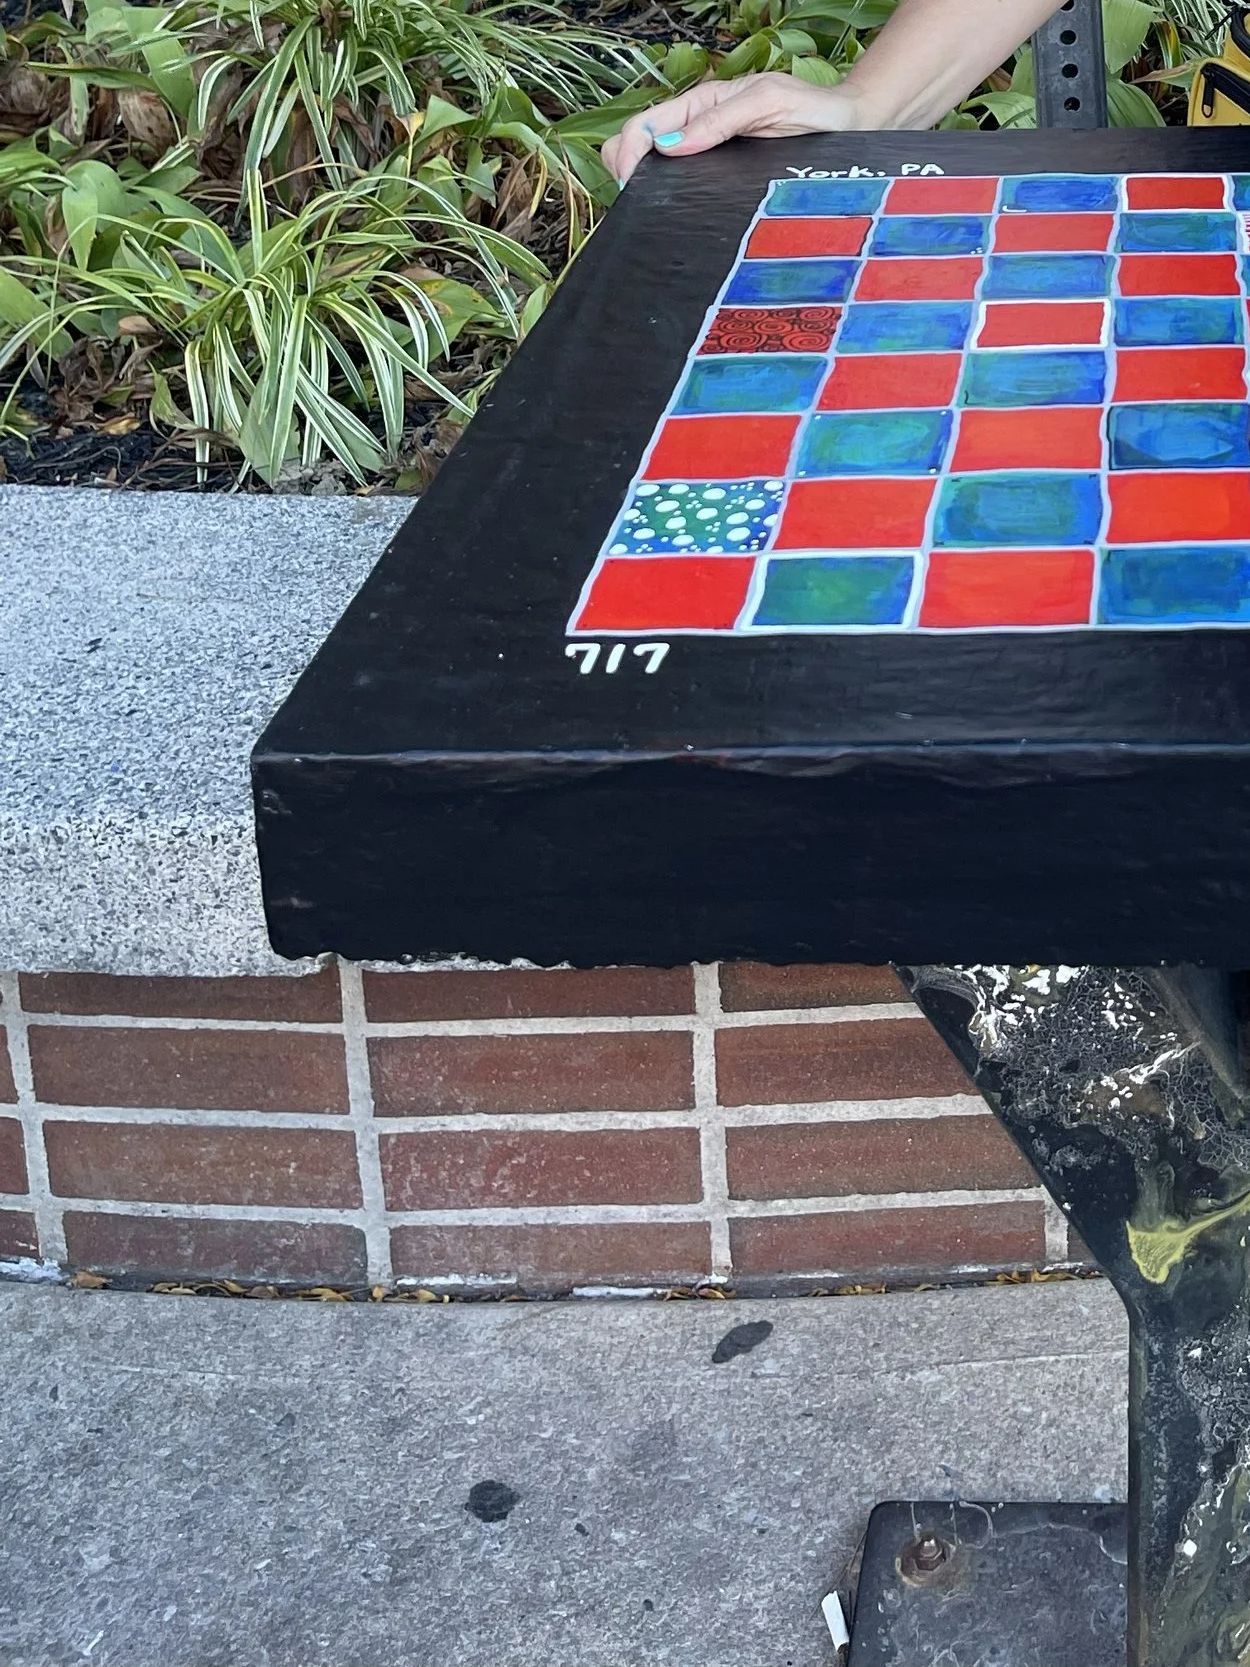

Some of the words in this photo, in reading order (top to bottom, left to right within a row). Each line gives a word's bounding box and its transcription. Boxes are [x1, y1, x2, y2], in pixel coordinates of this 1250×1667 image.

[786, 165, 886, 178] York,
[901, 163, 945, 176] PA
[565, 642, 670, 674] 717
